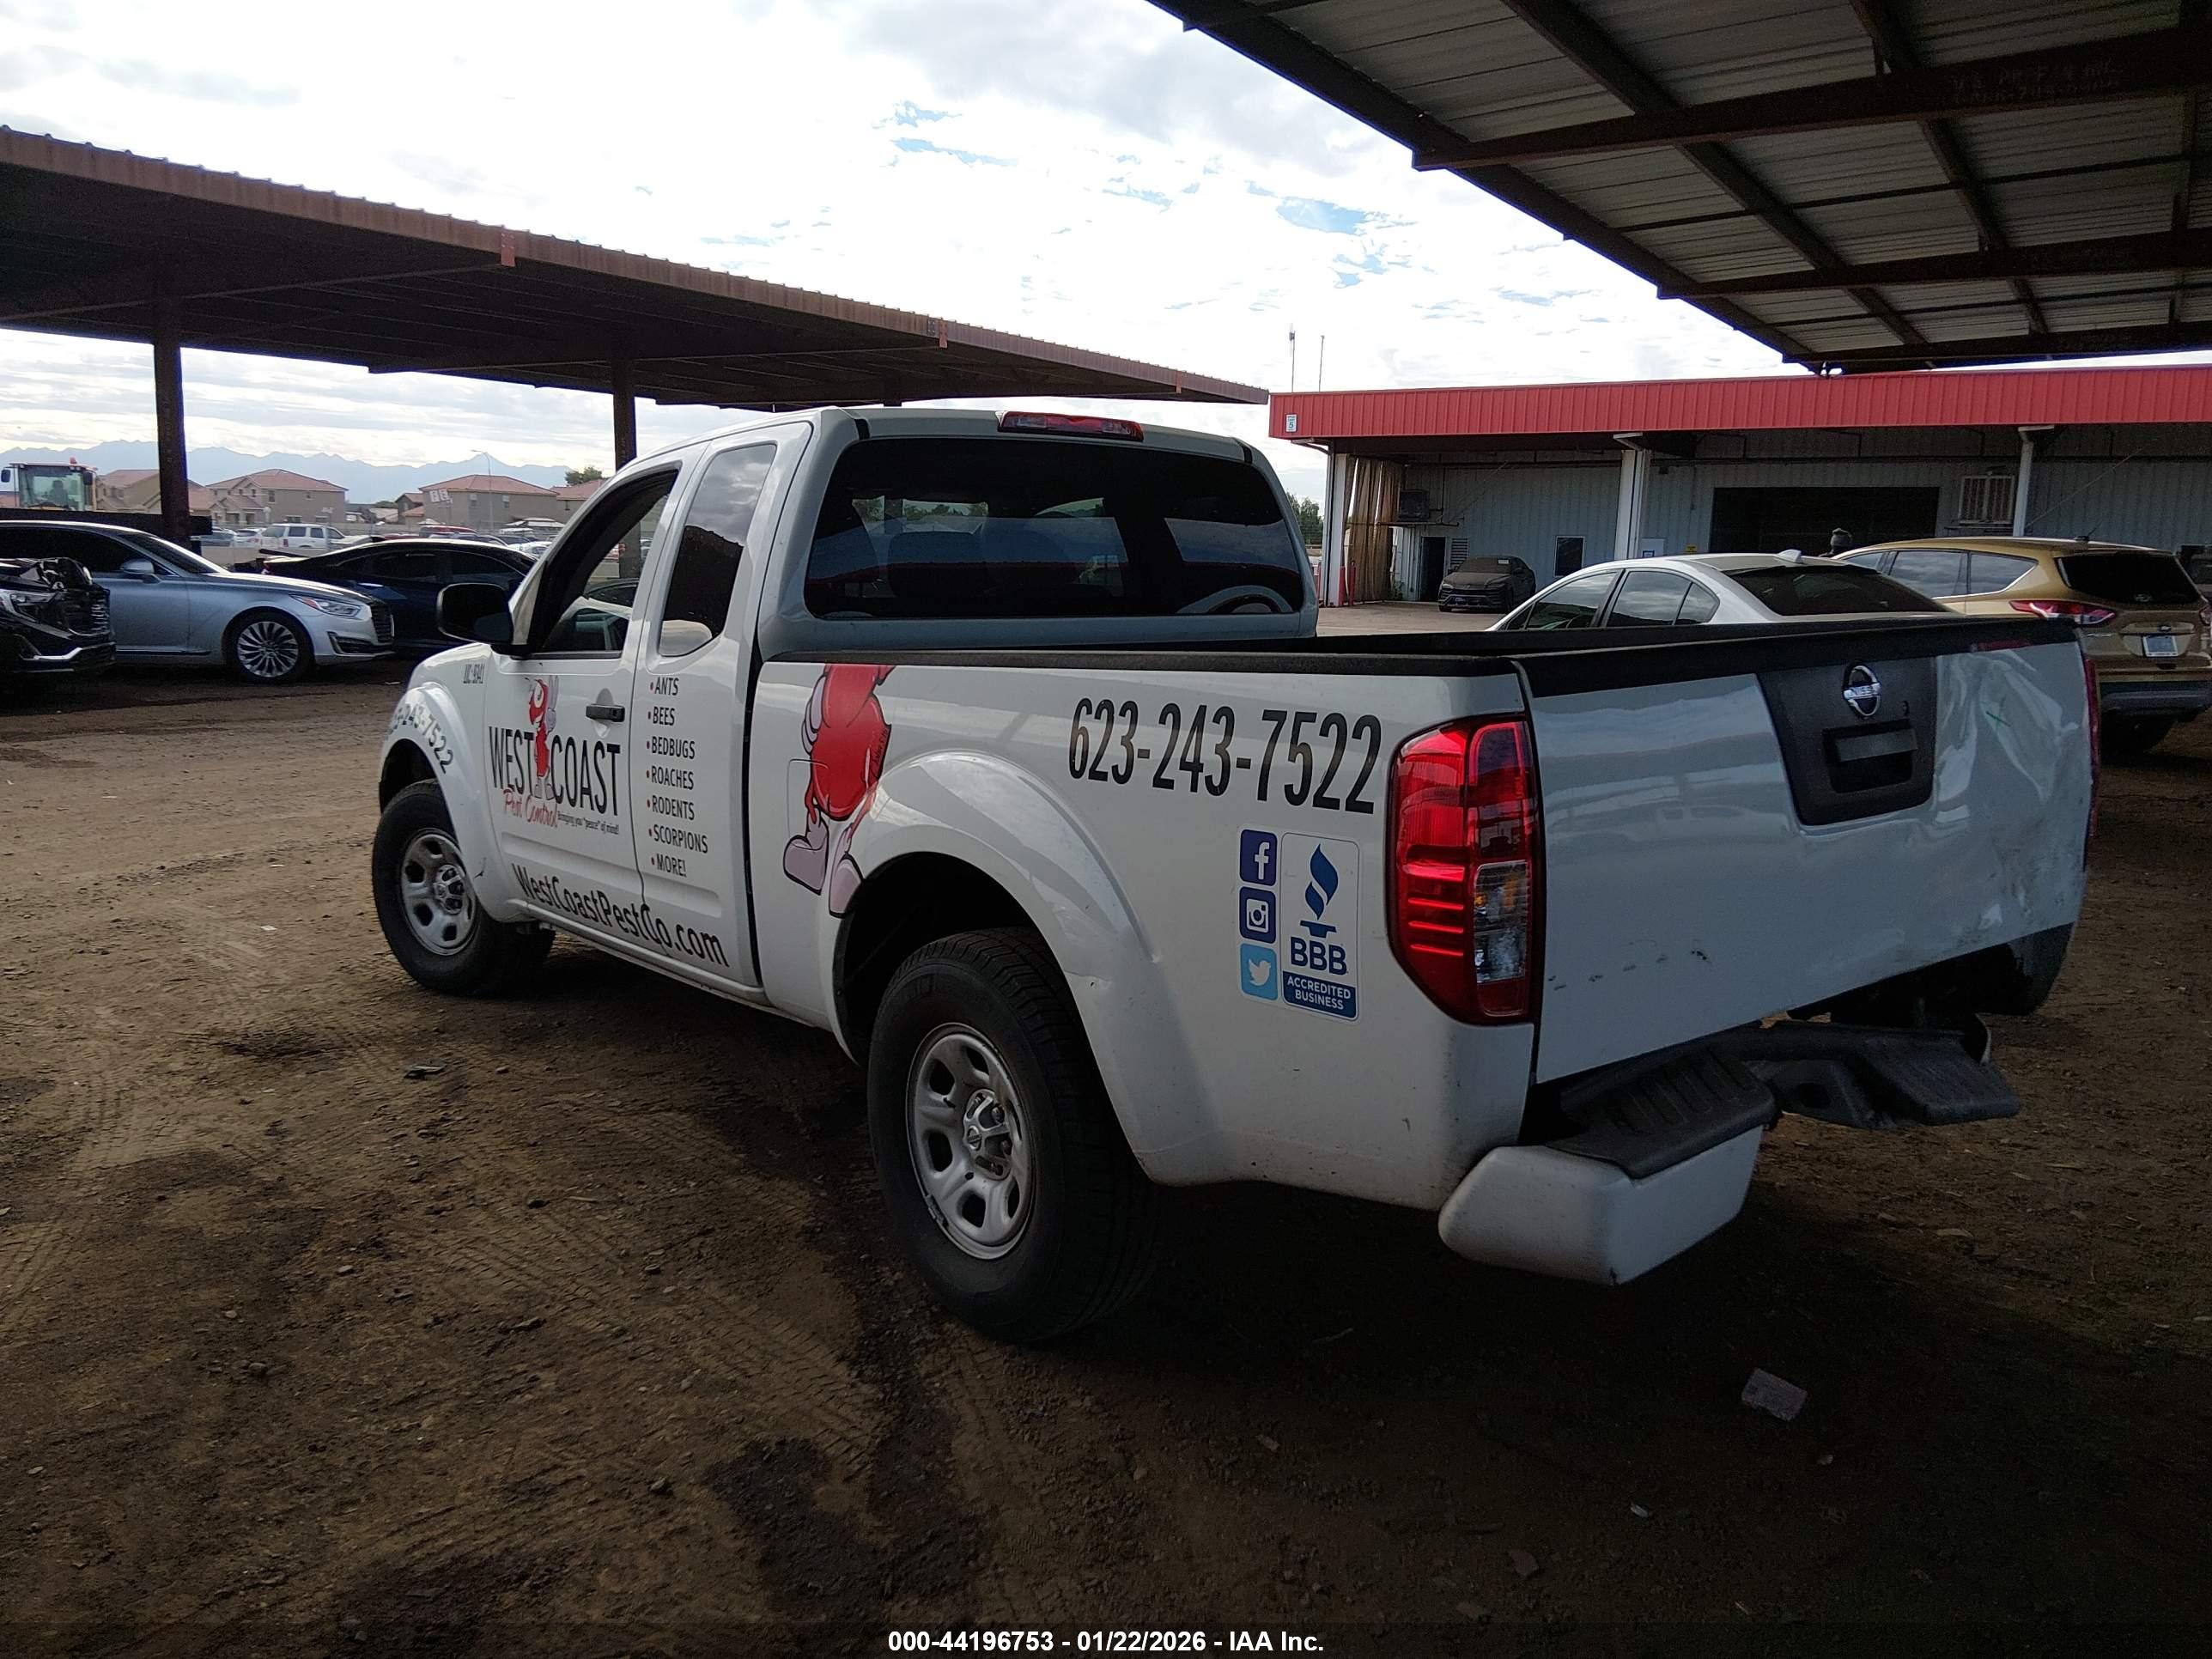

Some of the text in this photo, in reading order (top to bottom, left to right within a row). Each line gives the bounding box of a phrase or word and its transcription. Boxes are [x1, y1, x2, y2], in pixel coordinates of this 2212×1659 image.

[654, 677, 679, 696] ANTS
[653, 706, 675, 726] BEES
[651, 736, 696, 759] BEDBUGS
[1068, 697, 1382, 815] 623-243-7522
[489, 726, 621, 817] WEST COAST
[651, 765, 695, 790] ROACHES
[503, 789, 558, 829] Pest Control
[652, 794, 695, 821] RODENTS
[653, 823, 708, 854] SCORPIONS
[656, 853, 687, 877] MORE!
[511, 863, 730, 968] WestCoastPestCo.com
[1290, 936, 1347, 975] BBB
[1286, 975, 1352, 1000] ACCREDITED
[1294, 988, 1345, 1011] BUSINESS
